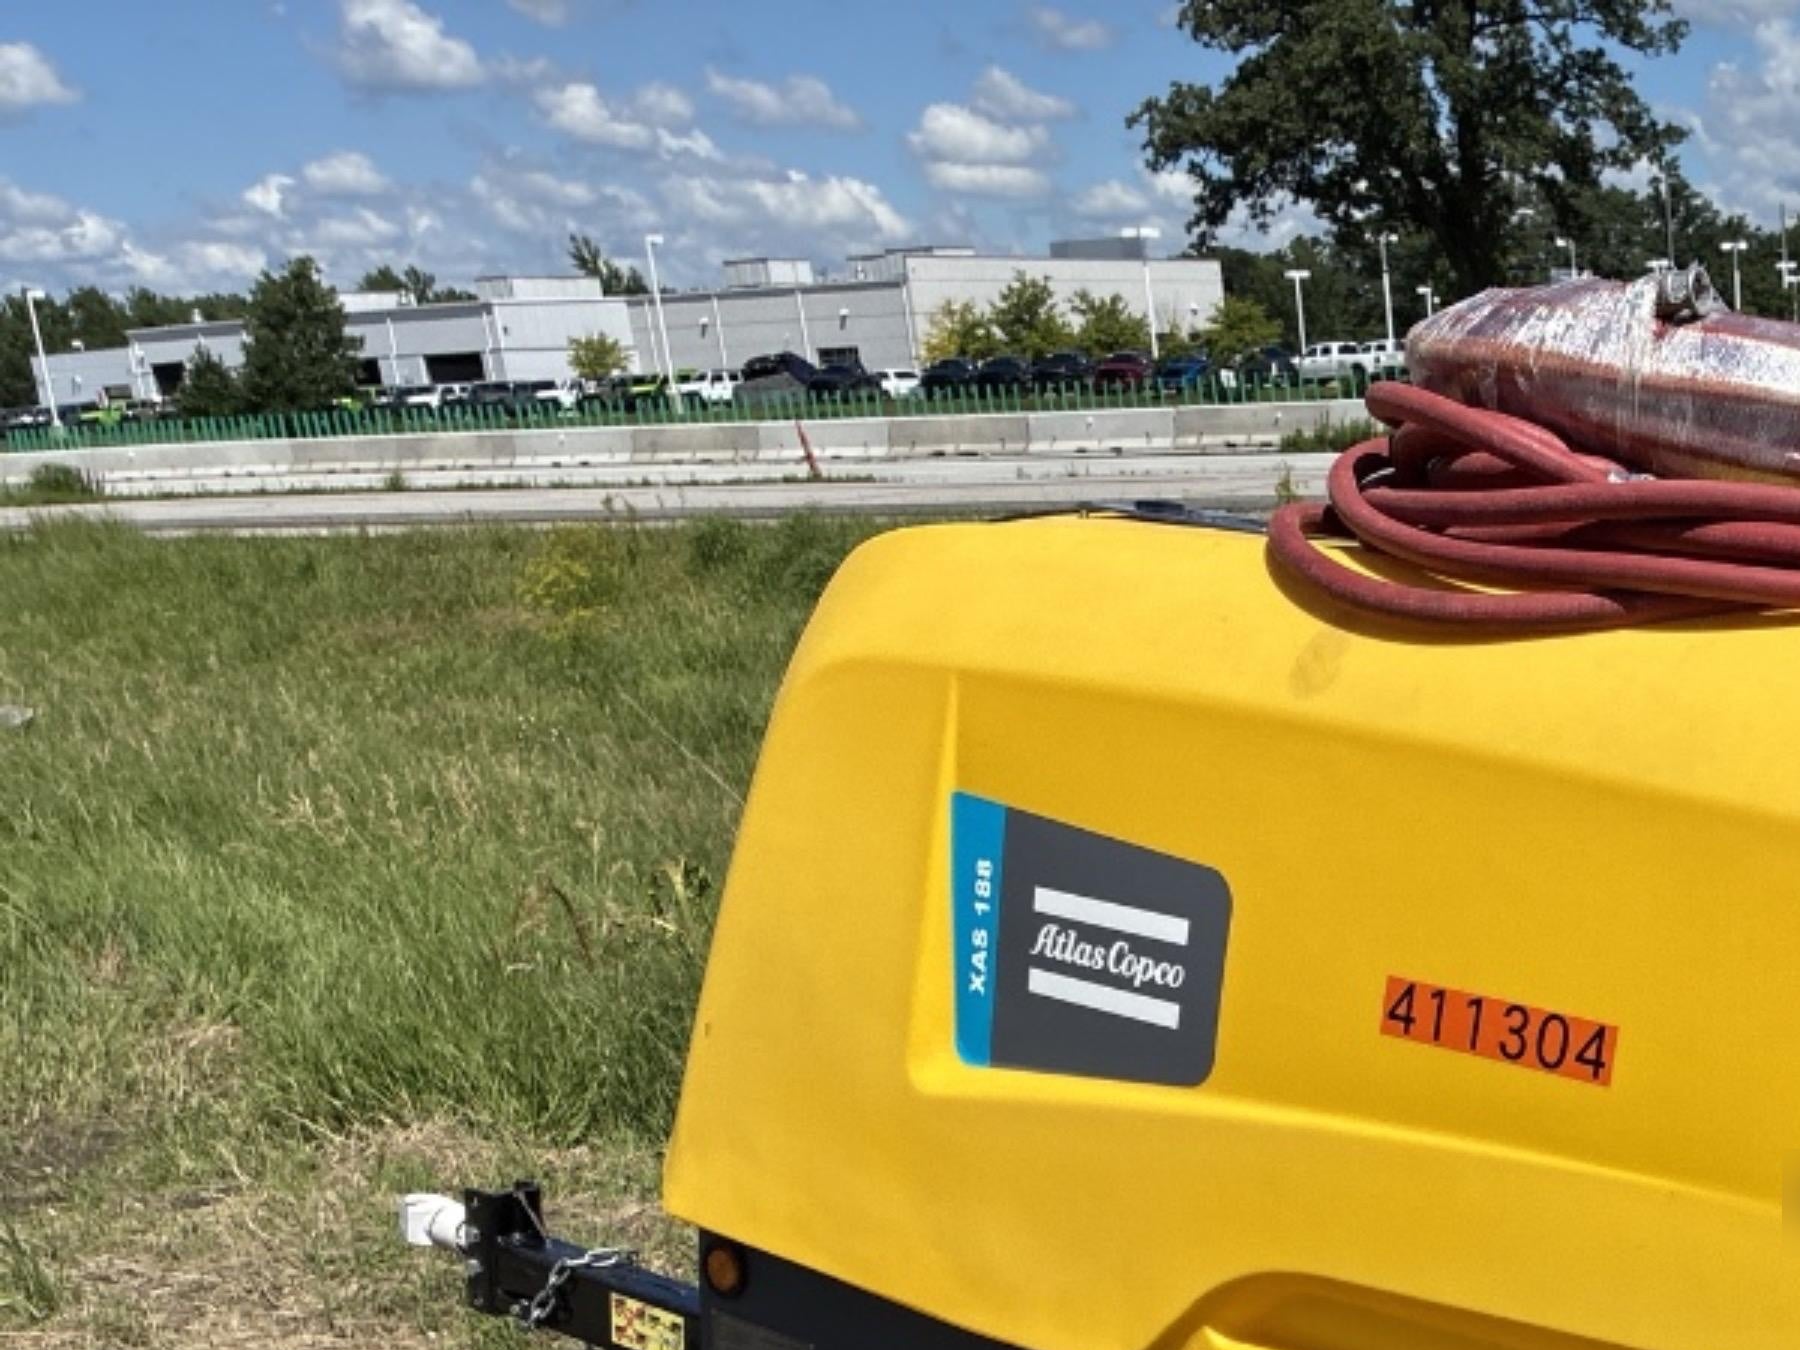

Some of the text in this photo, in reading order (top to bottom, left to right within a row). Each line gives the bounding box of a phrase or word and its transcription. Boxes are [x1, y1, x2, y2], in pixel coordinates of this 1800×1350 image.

[968, 928, 989, 996] XAS
[1029, 923, 1186, 988] Atlas Copco
[1388, 983, 1606, 1080] 411304
